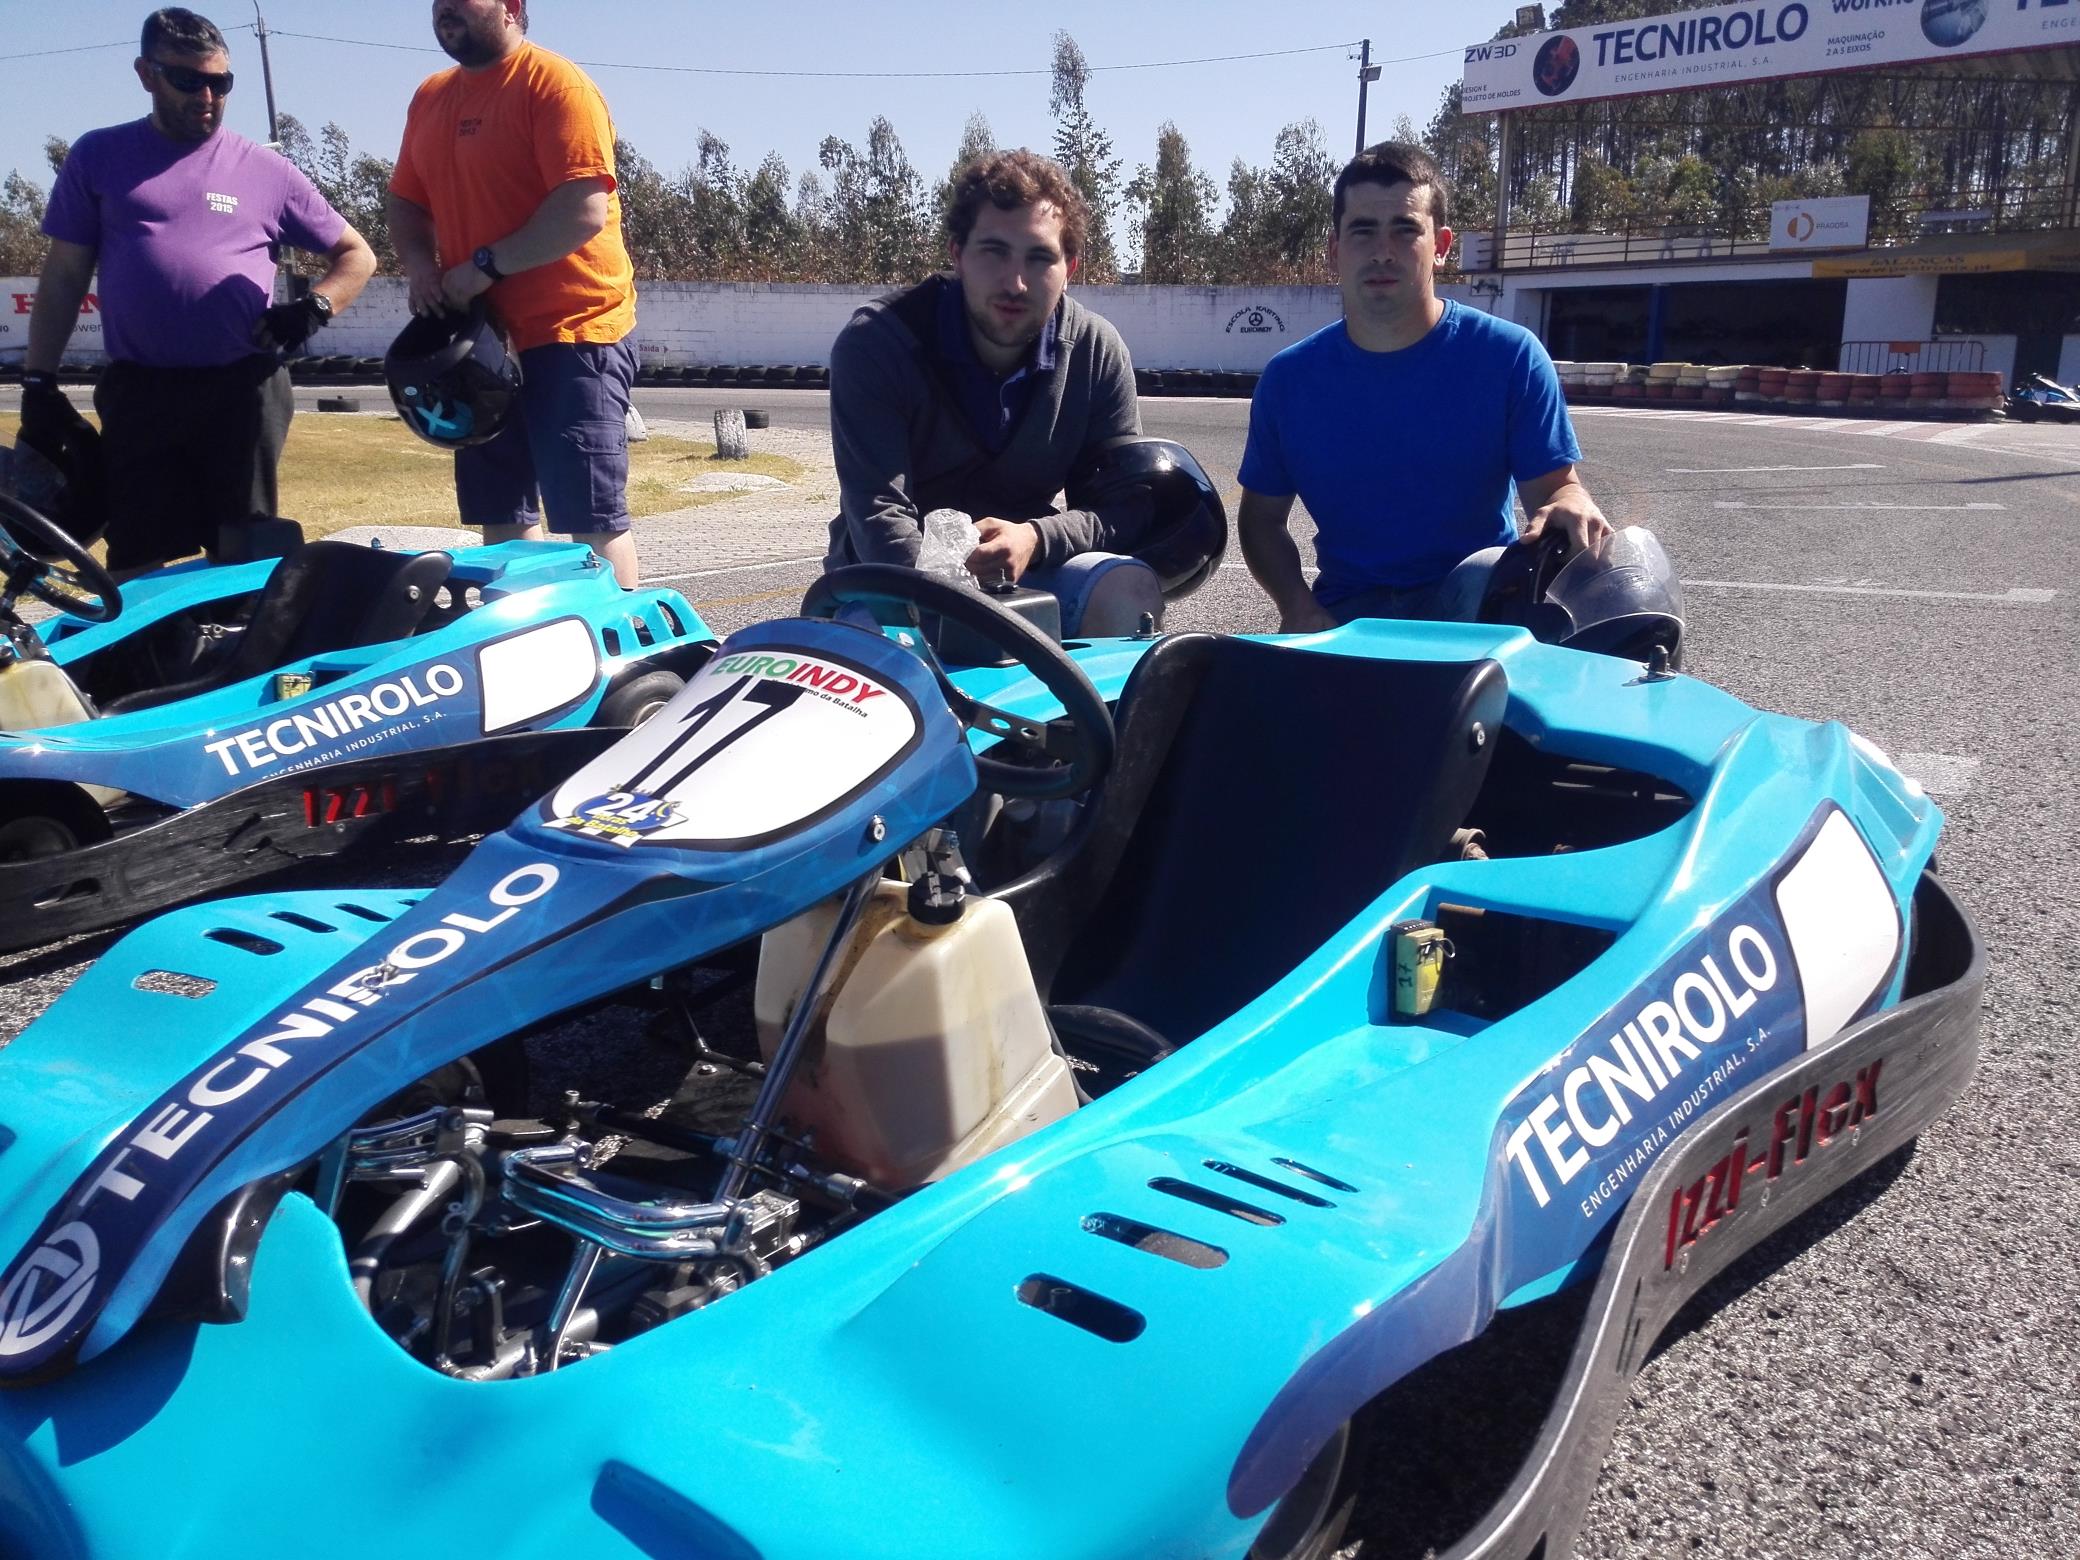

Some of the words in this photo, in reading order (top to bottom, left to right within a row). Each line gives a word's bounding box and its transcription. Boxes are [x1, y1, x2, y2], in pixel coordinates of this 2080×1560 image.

[1593, 3, 1808, 67] TECNIROLO
[1615, 68, 1677, 83] ENGENHARIA
[206, 192, 238, 205] FESTAS
[210, 202, 233, 213] 2015
[1225, 307, 1251, 333] ESCOLA
[1256, 306, 1285, 332] KARTING
[204, 664, 464, 776] TECNIROLO
[833, 697, 868, 718] Batalha
[585, 793, 664, 823] 24
[79, 862, 560, 1207] TECNIROLO
[1505, 924, 1777, 1208] TECNIROLO
[1581, 1129, 1668, 1218] ENGENHARIA
